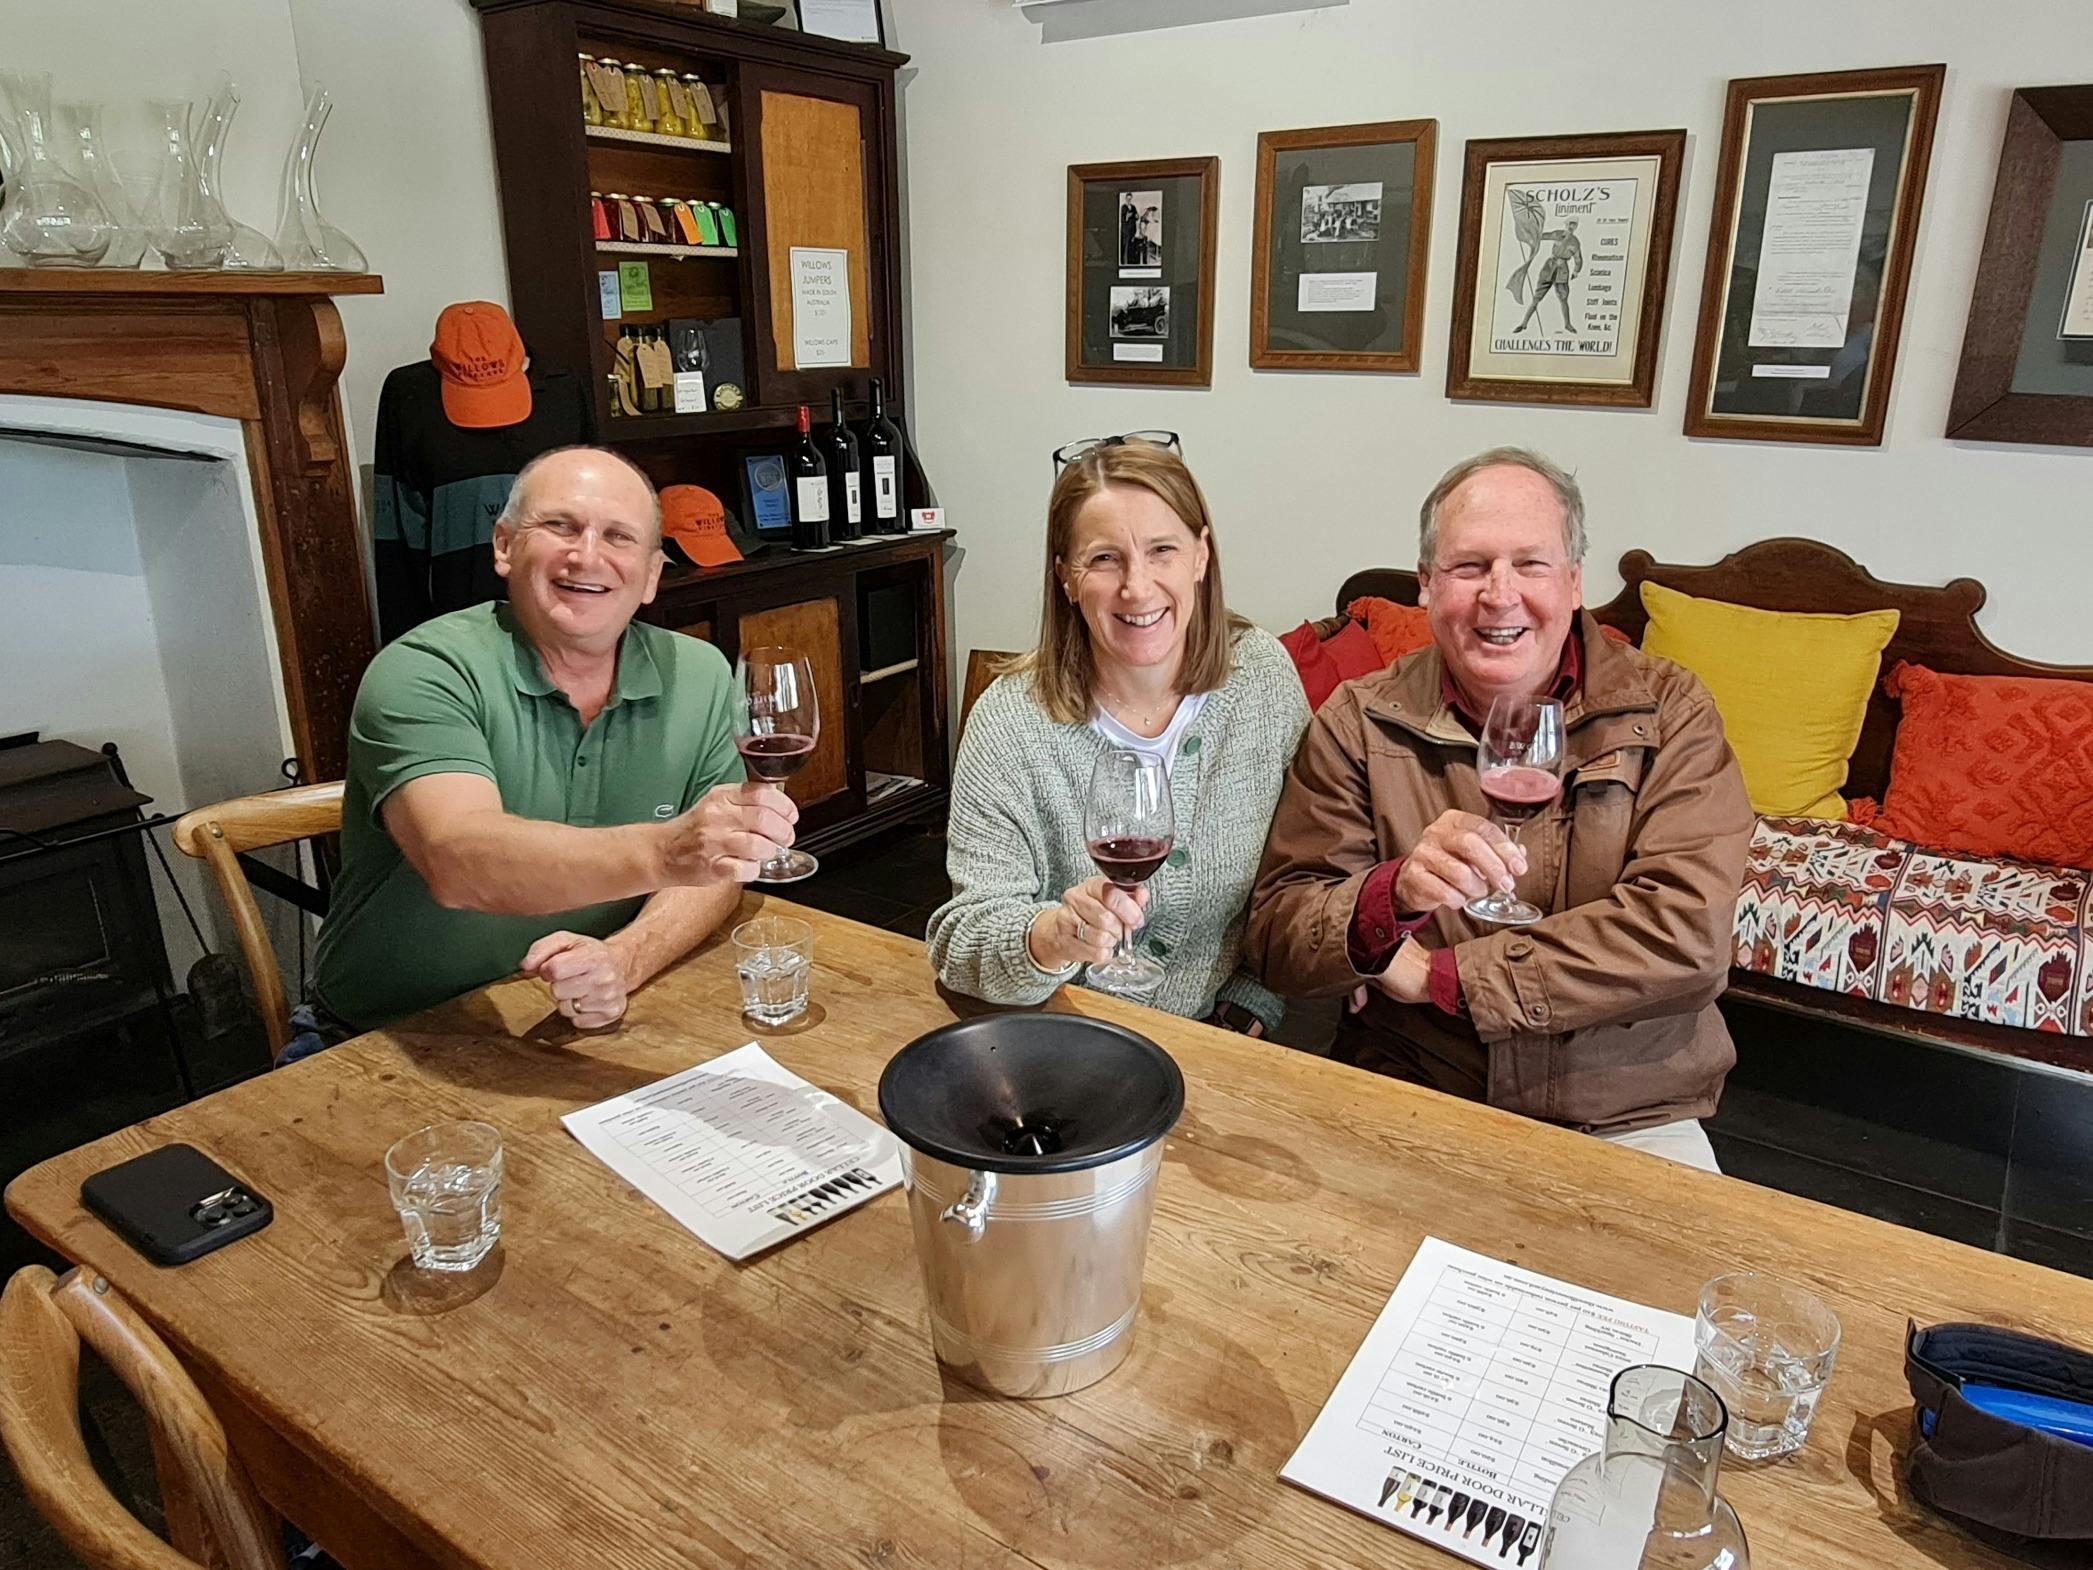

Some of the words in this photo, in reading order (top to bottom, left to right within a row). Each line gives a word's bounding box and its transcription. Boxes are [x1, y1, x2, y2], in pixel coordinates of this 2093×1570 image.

[1525, 186, 1611, 203] SCHOLZ'S
[801, 260, 832, 270] WILLOWS
[802, 276, 832, 285] JUMPERS
[1495, 339, 1551, 351] CHALLENGES
[1555, 340, 1575, 351] THE
[1579, 341, 1612, 352] WORLD!
[1384, 1446, 1415, 1463] LIST
[1417, 1458, 1459, 1481] PRICE
[1462, 1476, 1504, 1499] DOOR
